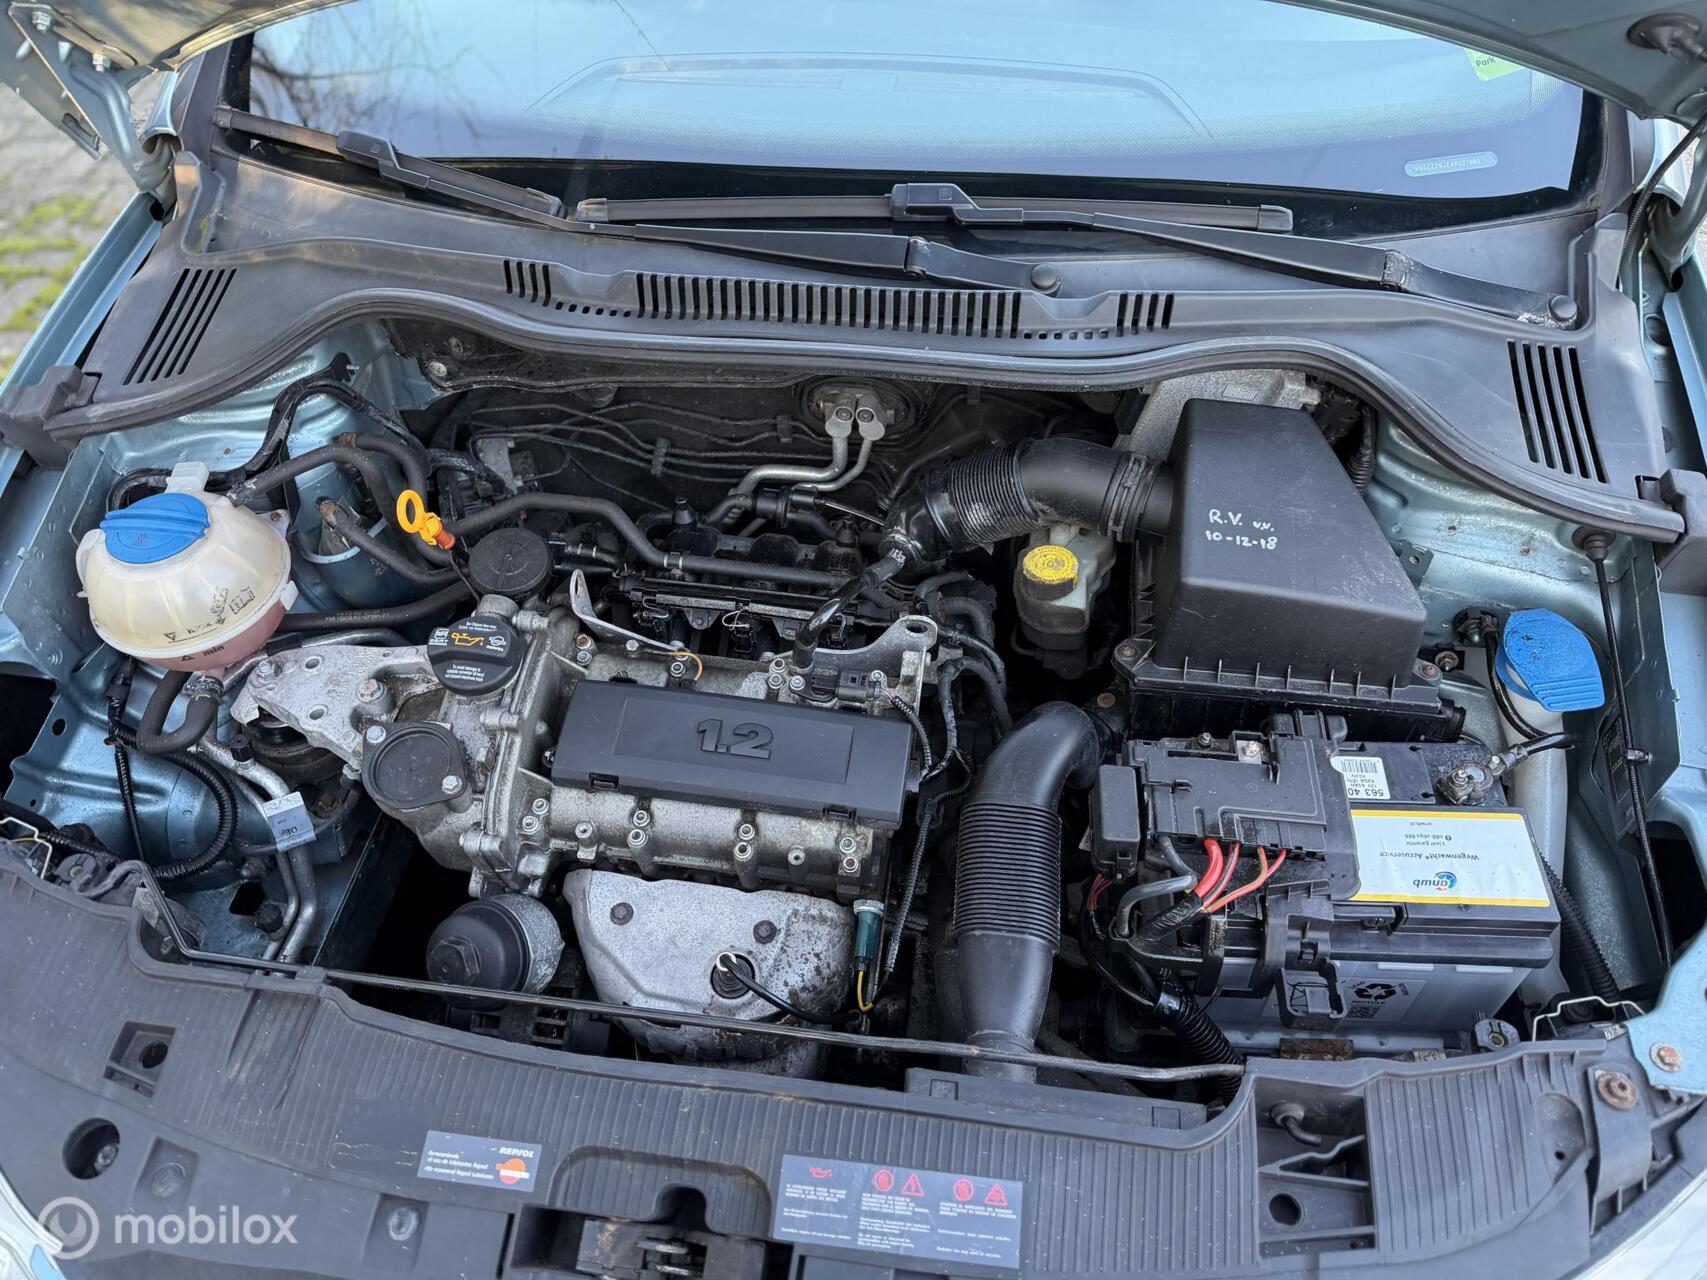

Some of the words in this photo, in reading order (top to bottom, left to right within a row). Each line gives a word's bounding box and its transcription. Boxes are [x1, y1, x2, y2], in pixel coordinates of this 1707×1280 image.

[1208, 509, 1243, 526] R.V.
[1205, 530, 1278, 550] 10-12-18
[203, 645, 225, 657] min
[697, 718, 773, 760] 1.2
[1364, 789, 1384, 797] 563
[1413, 877, 1448, 888] anwb
[499, 1146, 535, 1158] REPSOL
